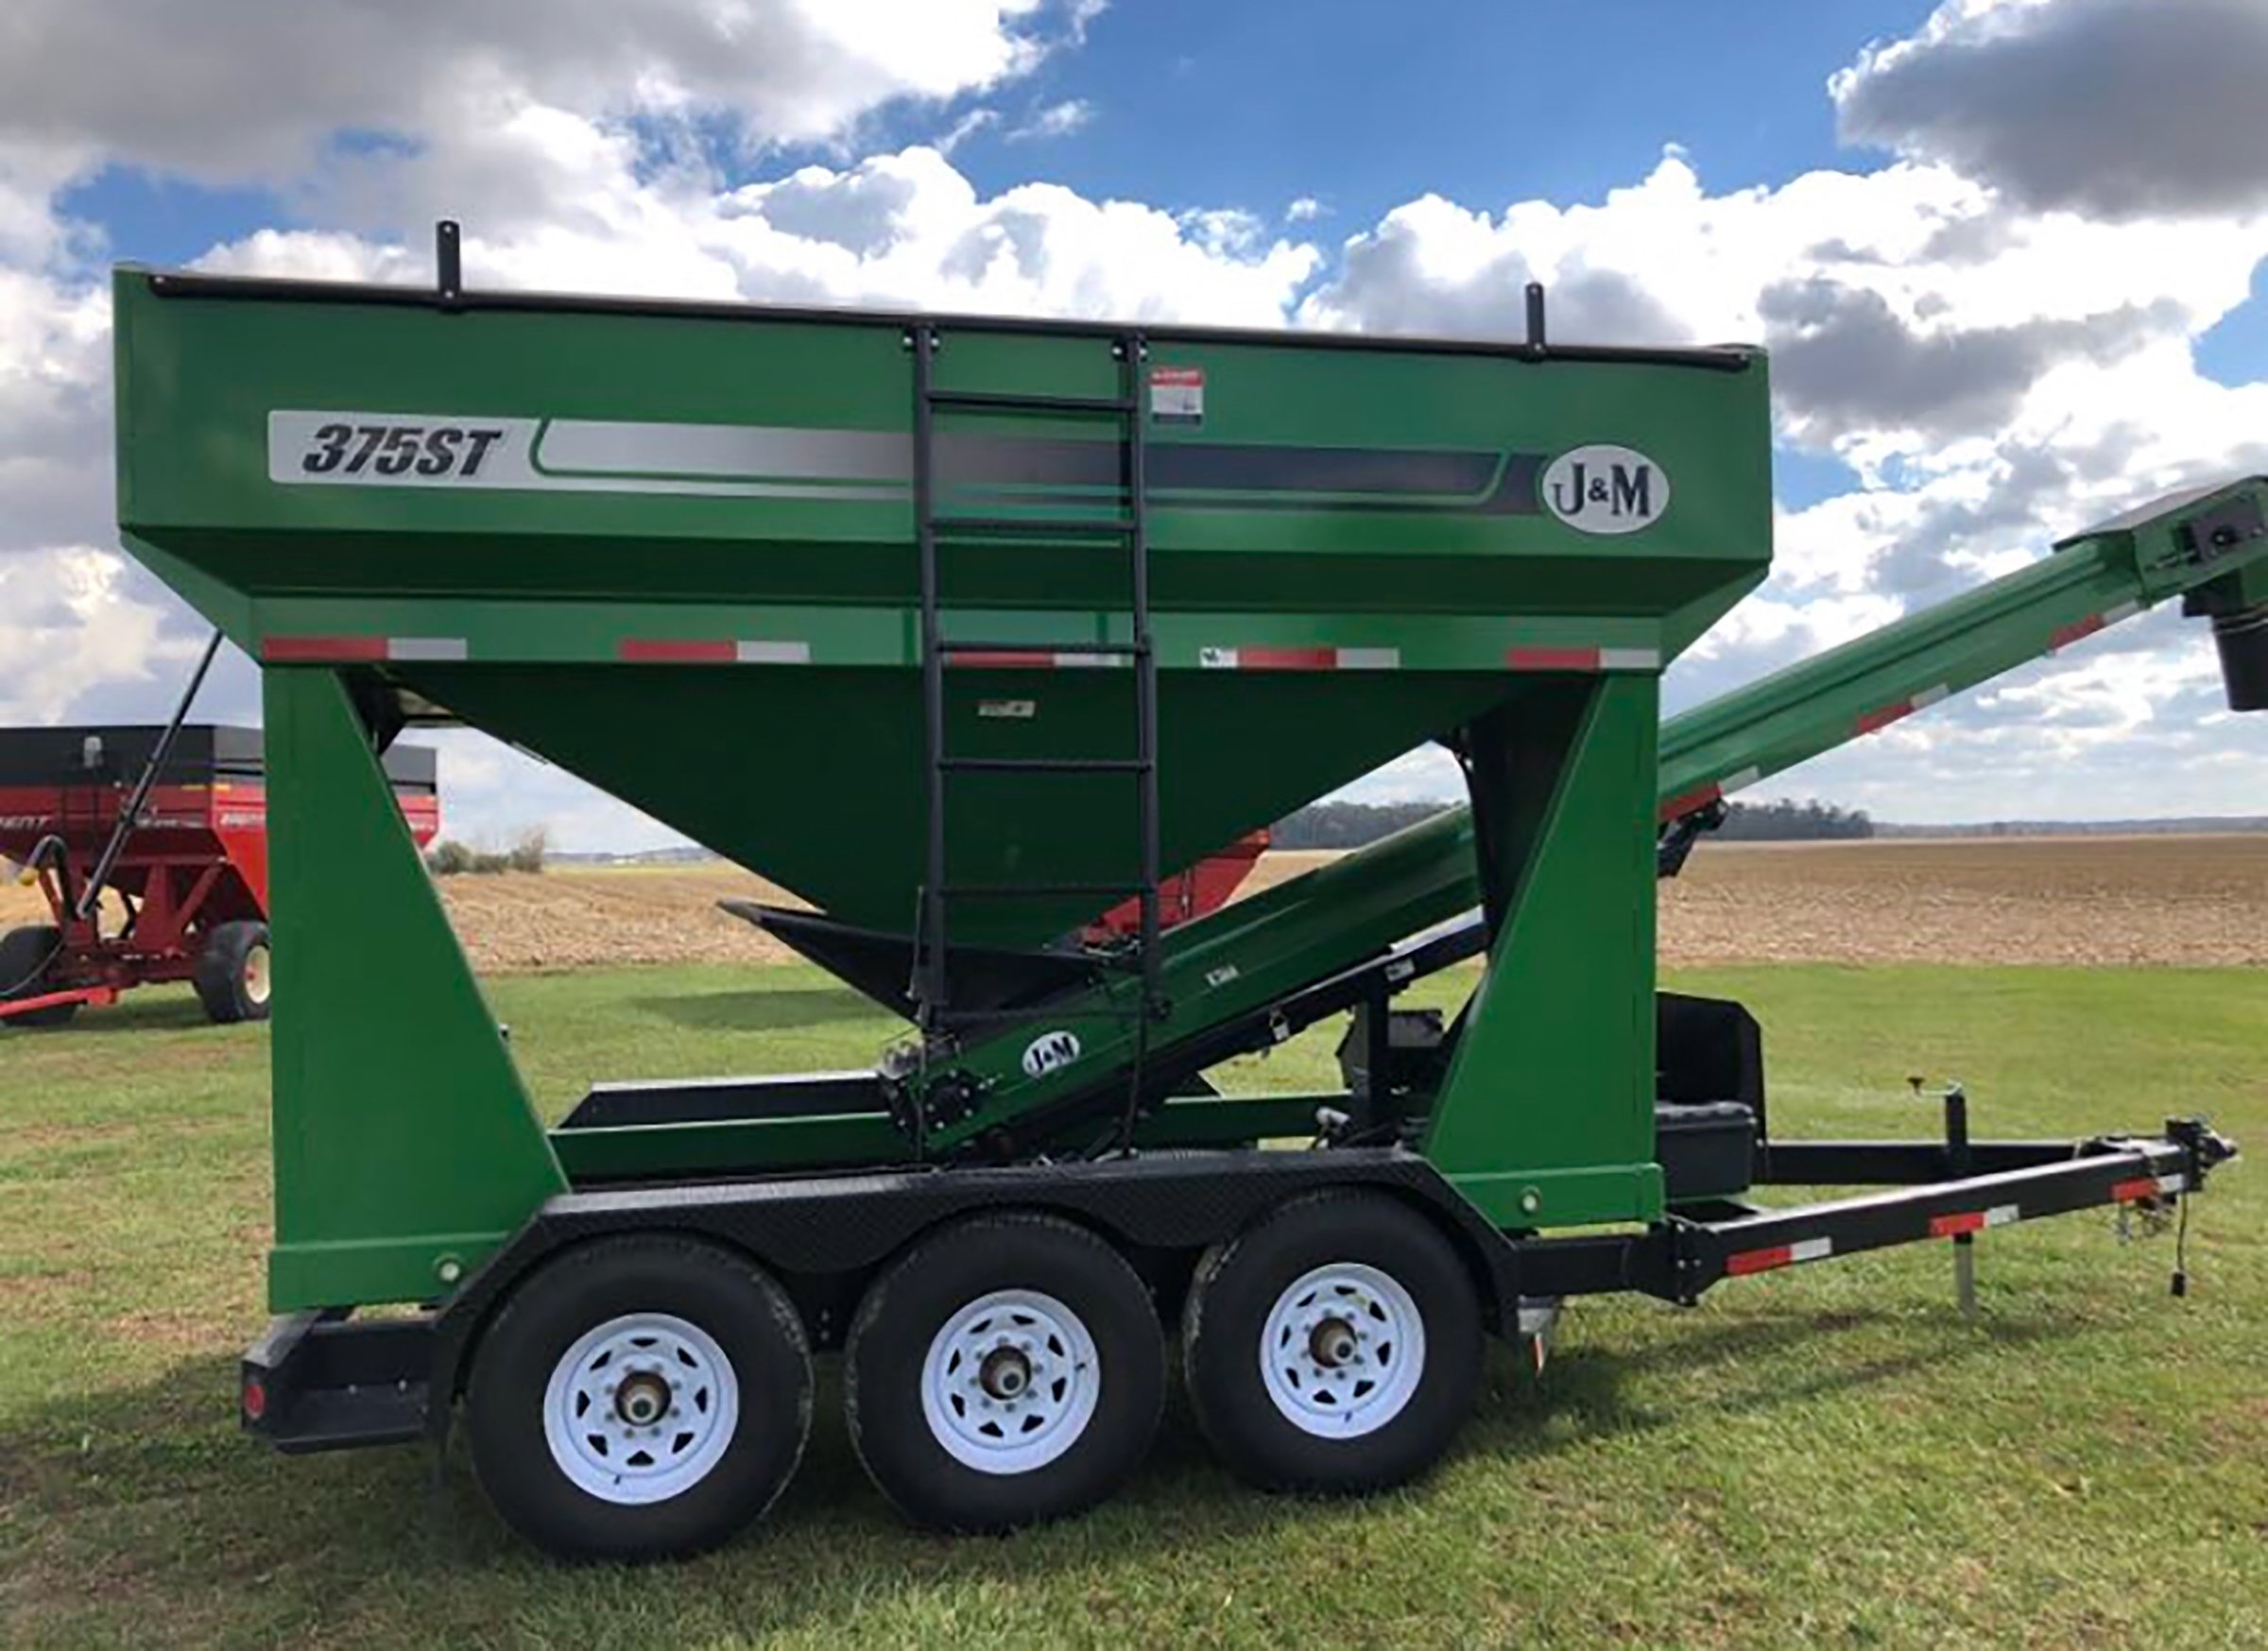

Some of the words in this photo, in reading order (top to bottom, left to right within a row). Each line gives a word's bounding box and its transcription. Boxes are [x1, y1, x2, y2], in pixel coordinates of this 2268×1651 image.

[301, 423, 503, 475] 375ST
[1551, 462, 1650, 517] J&M
[0, 816, 51, 832] ENT
[1026, 1035, 1074, 1073] J&M
